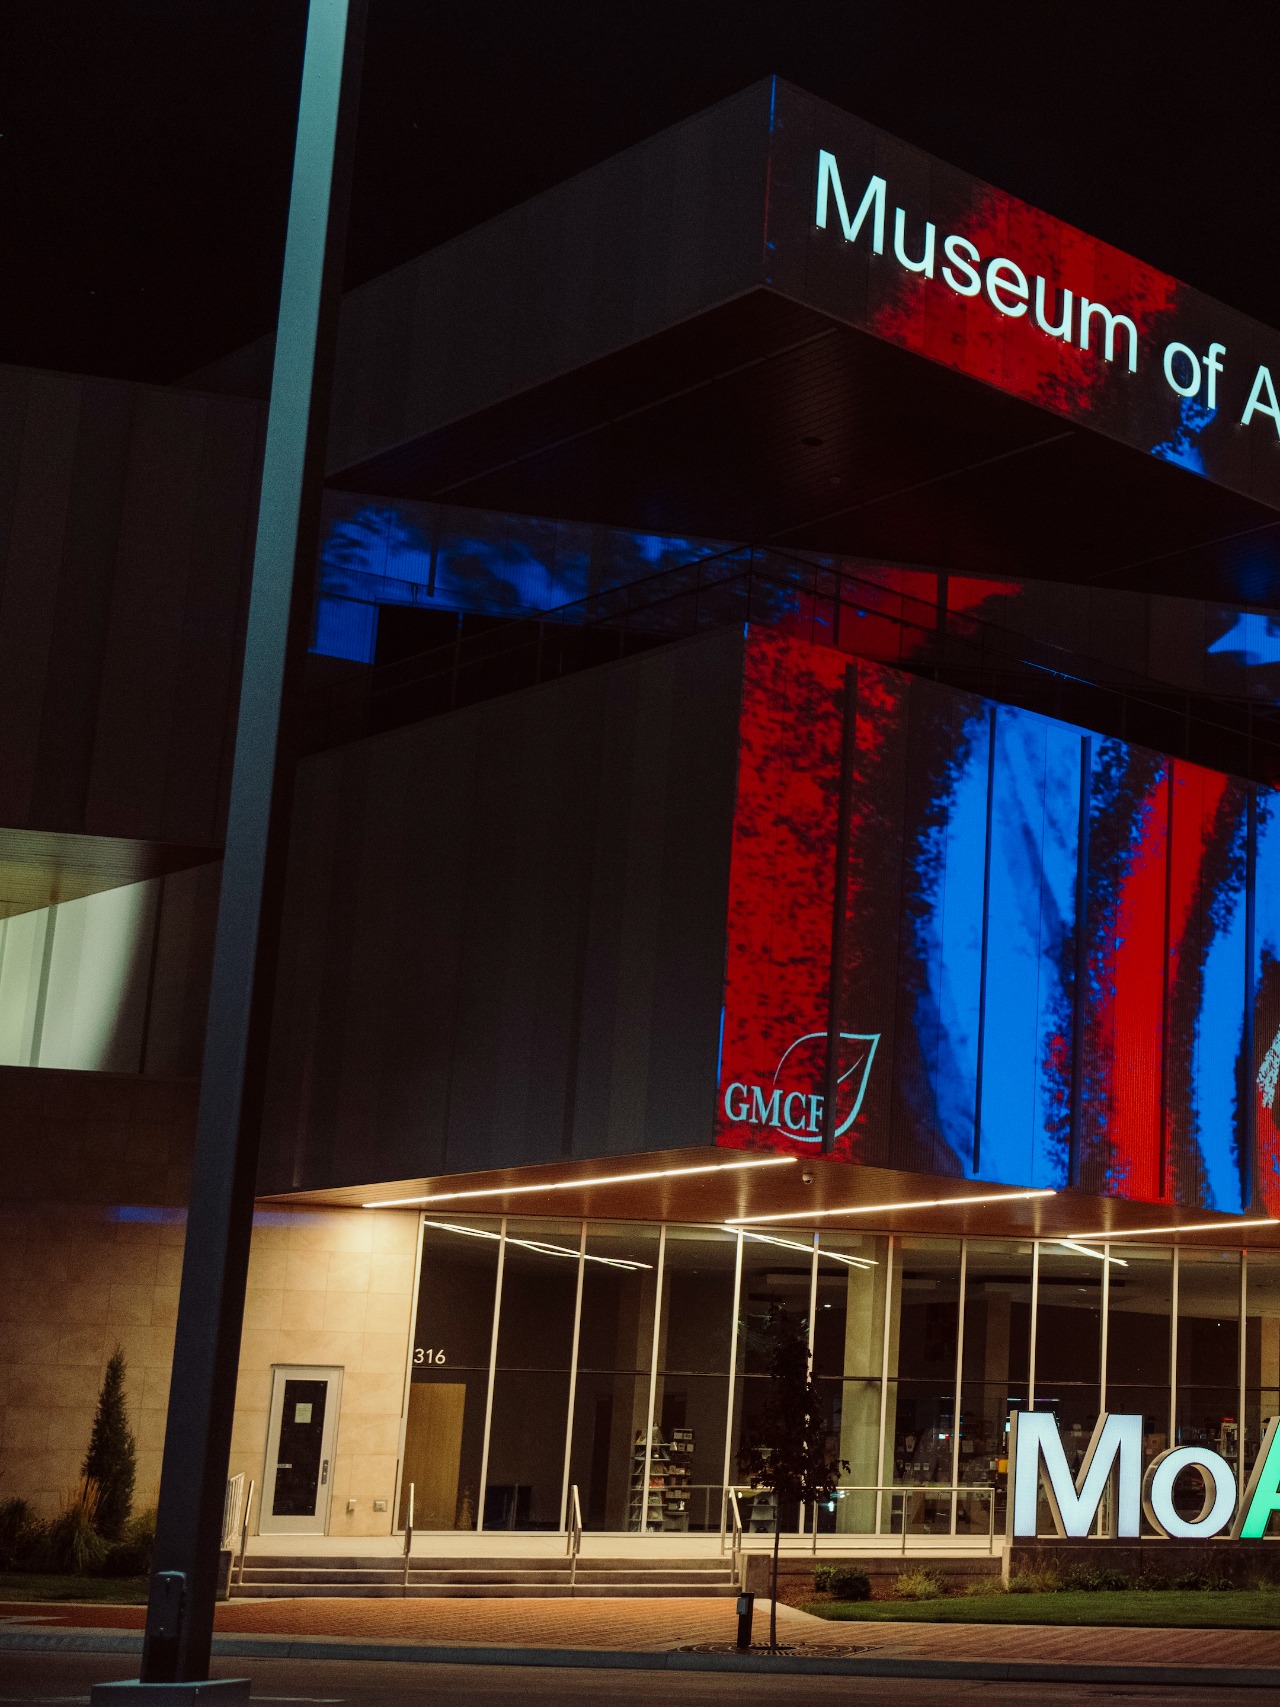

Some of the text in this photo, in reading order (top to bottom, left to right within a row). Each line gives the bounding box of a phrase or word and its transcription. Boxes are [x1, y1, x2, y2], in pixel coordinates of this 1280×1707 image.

[815, 148, 1138, 374] Museum
[1163, 341, 1227, 410] of
[724, 1082, 826, 1132] GMCF
[412, 1348, 446, 1365] 316
